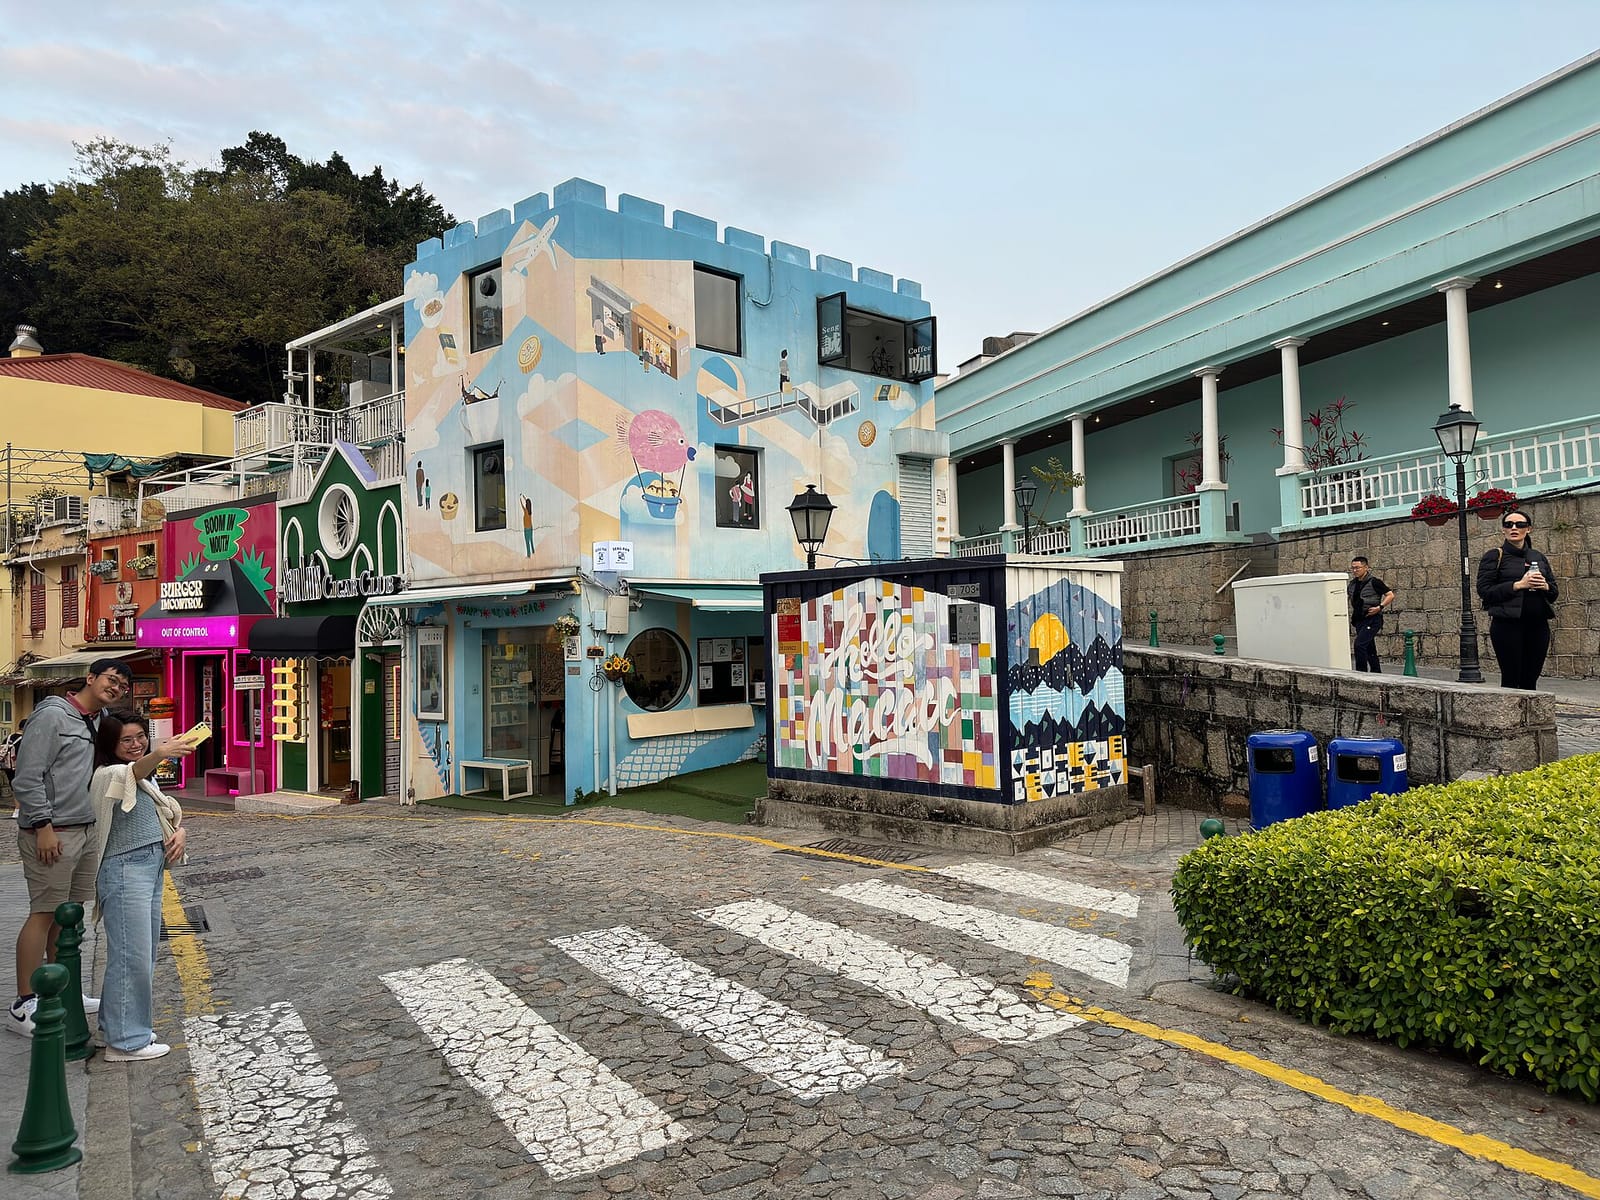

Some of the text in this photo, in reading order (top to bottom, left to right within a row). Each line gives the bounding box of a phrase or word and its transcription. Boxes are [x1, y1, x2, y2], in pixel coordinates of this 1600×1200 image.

[822, 324, 840, 334] Seng
[908, 345, 932, 355] Coffee
[204, 513, 236, 535] BOOM IN
[209, 534, 230, 554] MOUTH
[160, 580, 203, 598] BURGER
[161, 627, 208, 637] OUT OF CONTROL
